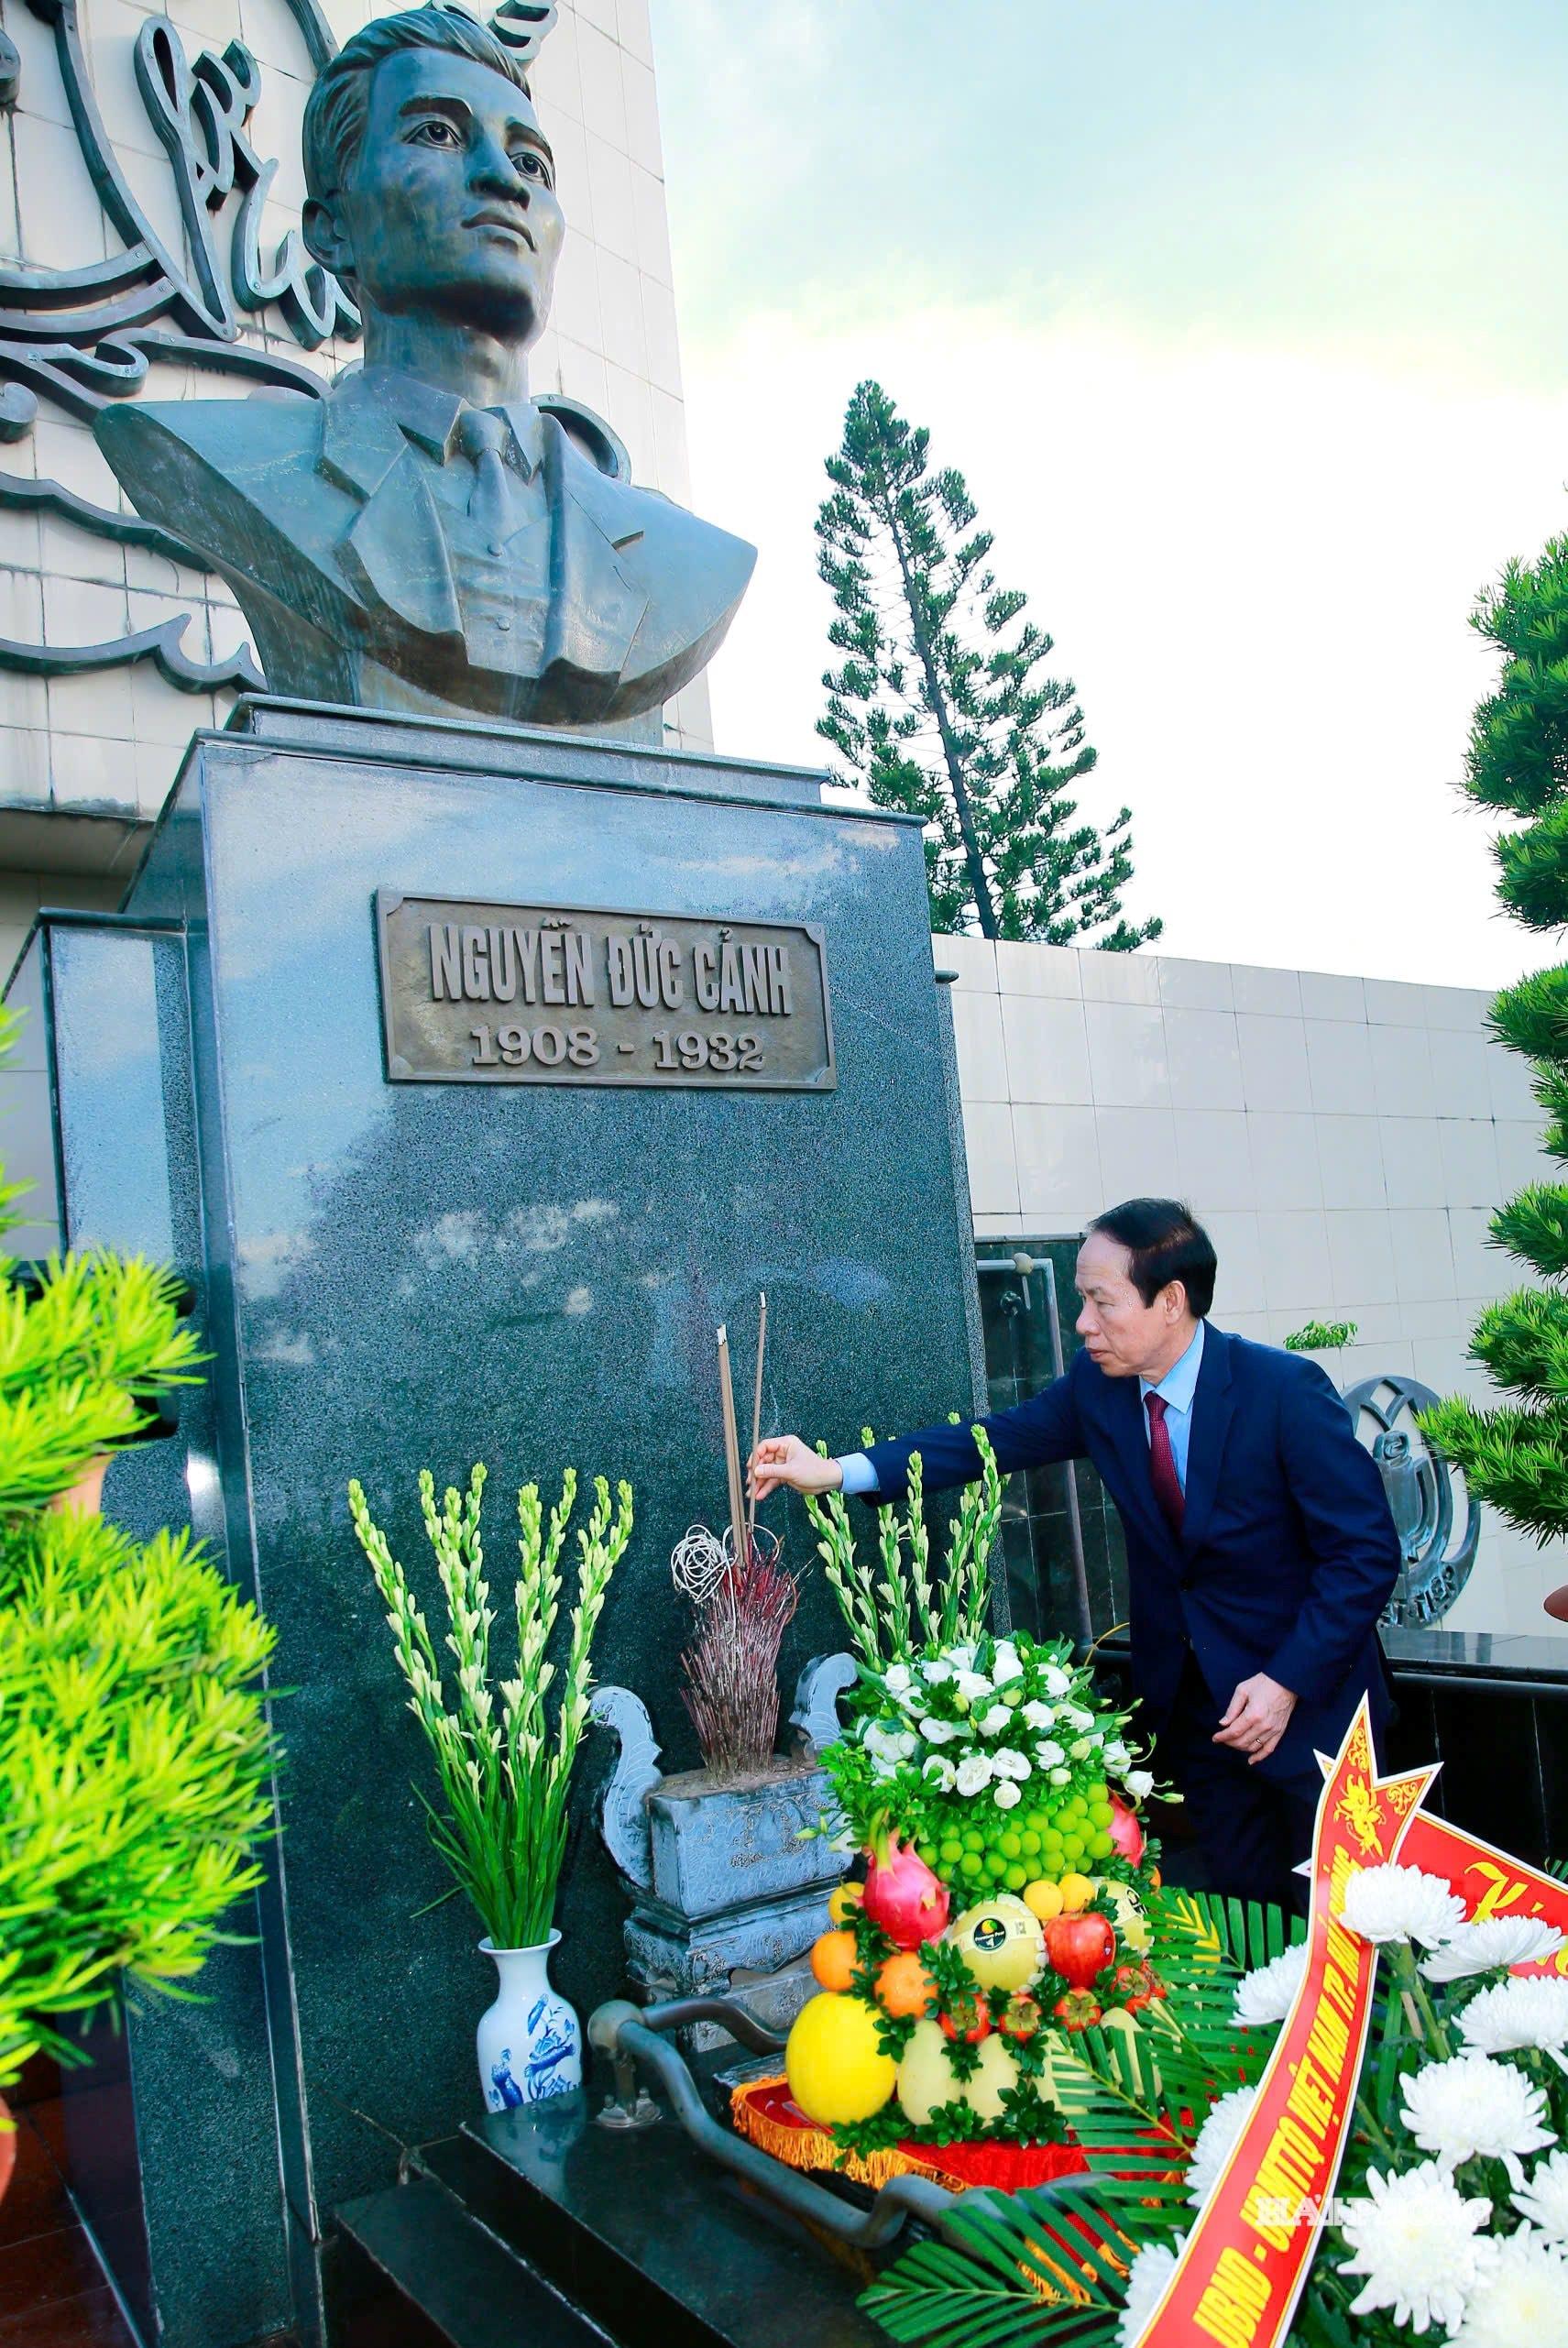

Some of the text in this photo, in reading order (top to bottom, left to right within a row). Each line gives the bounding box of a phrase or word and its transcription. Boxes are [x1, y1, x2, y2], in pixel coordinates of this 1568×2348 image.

[429, 916, 792, 1015] NGUYỄN ĐỨC CẢNH
[471, 1025, 766, 1070] 1908 - 1932
[1306, 1992, 1350, 2086] NAM
[1286, 2053, 1341, 2141] VIỆT
[1193, 2246, 1273, 2348] UBND
